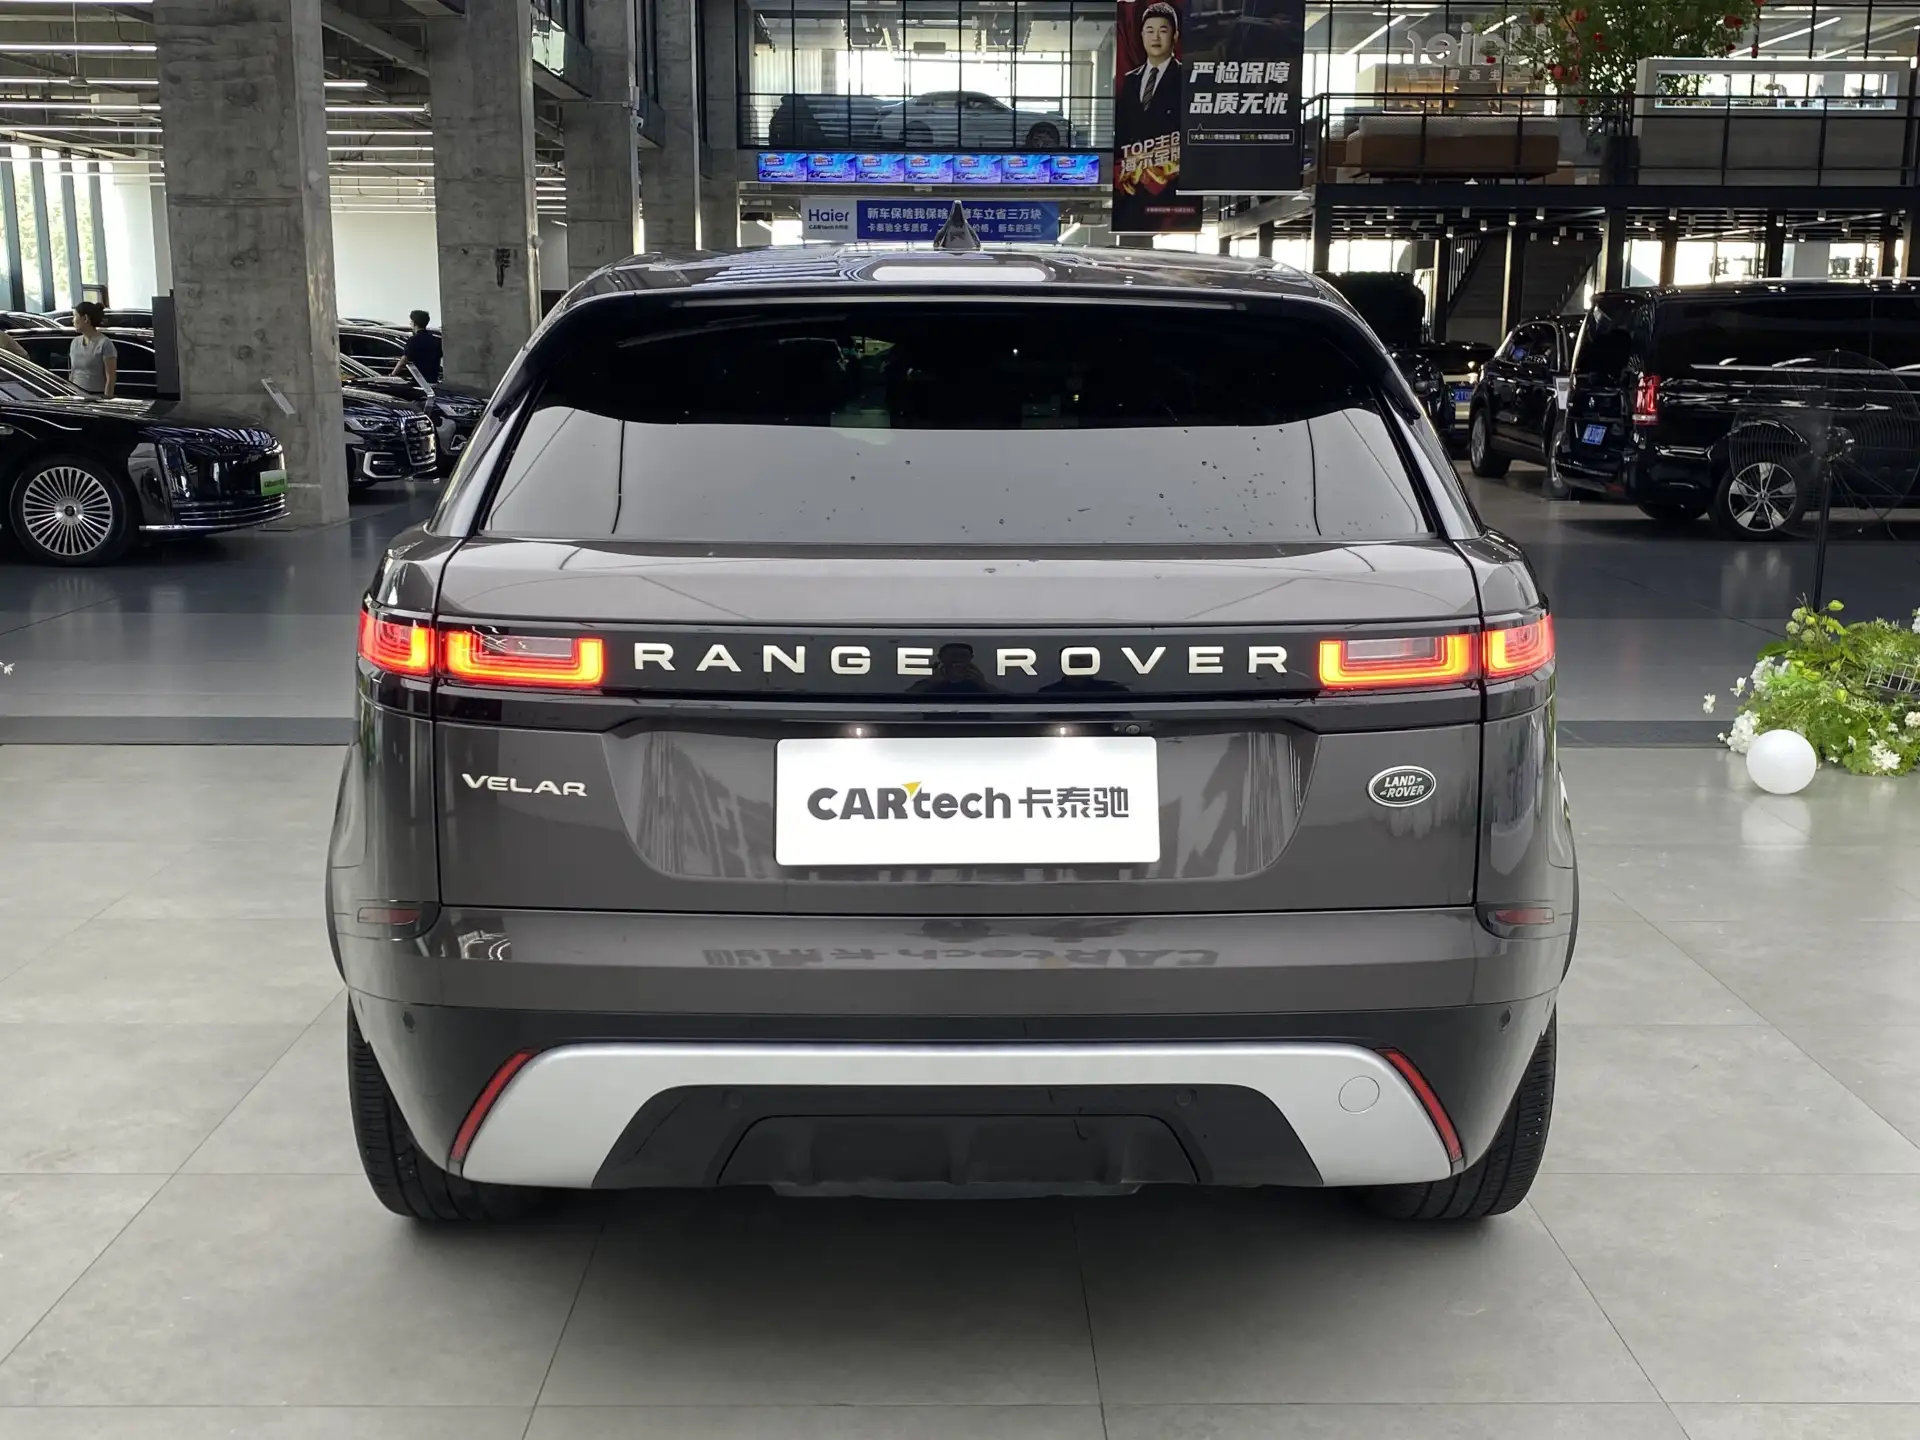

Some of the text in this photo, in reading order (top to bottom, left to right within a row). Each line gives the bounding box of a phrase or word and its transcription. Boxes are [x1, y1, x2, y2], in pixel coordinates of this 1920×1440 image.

[1189, 61, 1291, 84] 严检保障
[1189, 92, 1289, 115] 品质无忧
[808, 208, 850, 222] Haier
[634, 642, 1288, 676] RANGE ROVER
[461, 773, 588, 797] VELAR
[1384, 775, 1416, 788] LAND
[1386, 785, 1425, 798] ROVER
[807, 786, 1129, 821] CARtech 卡泰驰
